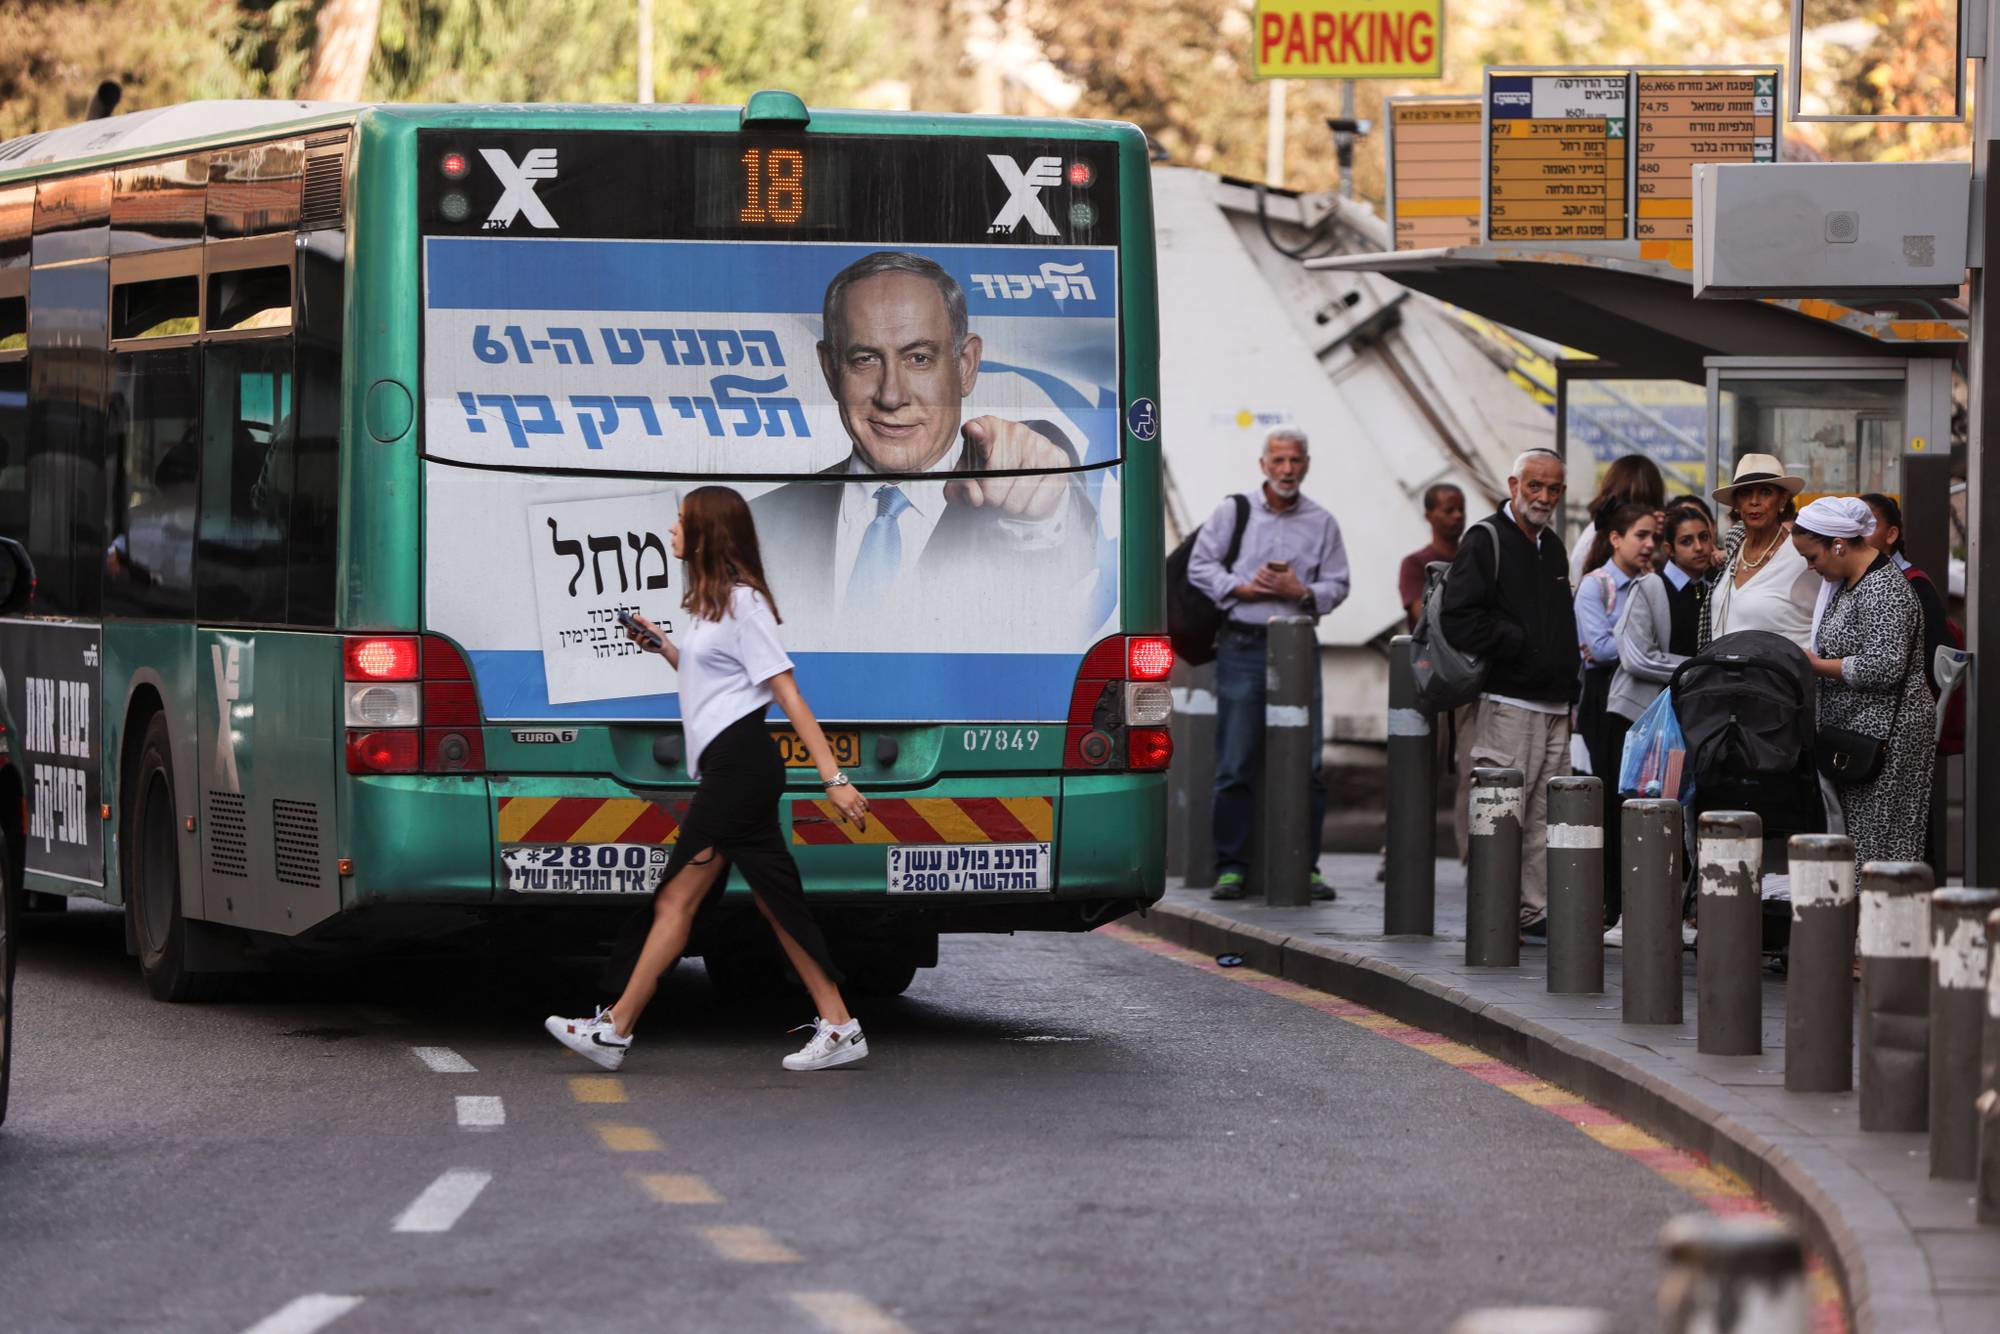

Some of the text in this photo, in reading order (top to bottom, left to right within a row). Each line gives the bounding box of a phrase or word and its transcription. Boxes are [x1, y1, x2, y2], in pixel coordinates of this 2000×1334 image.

[1261, 11, 1434, 64] PARKING
[739, 148, 802, 223] 18
[970, 262, 1096, 301] הליכוד
[472, 325, 786, 368] המנדט ה-61
[456, 374, 812, 450] תלוי רק בך!
[547, 516, 669, 598] מחל
[559, 627, 607, 649] בנימין
[26, 676, 90, 758] פעם אחת
[517, 731, 574, 743] EURO 6
[964, 729, 1040, 751] 07849
[946, 847, 990, 871] פולט
[994, 849, 1038, 870] הרכב
[515, 865, 645, 893] איך הנהיגה שלי
